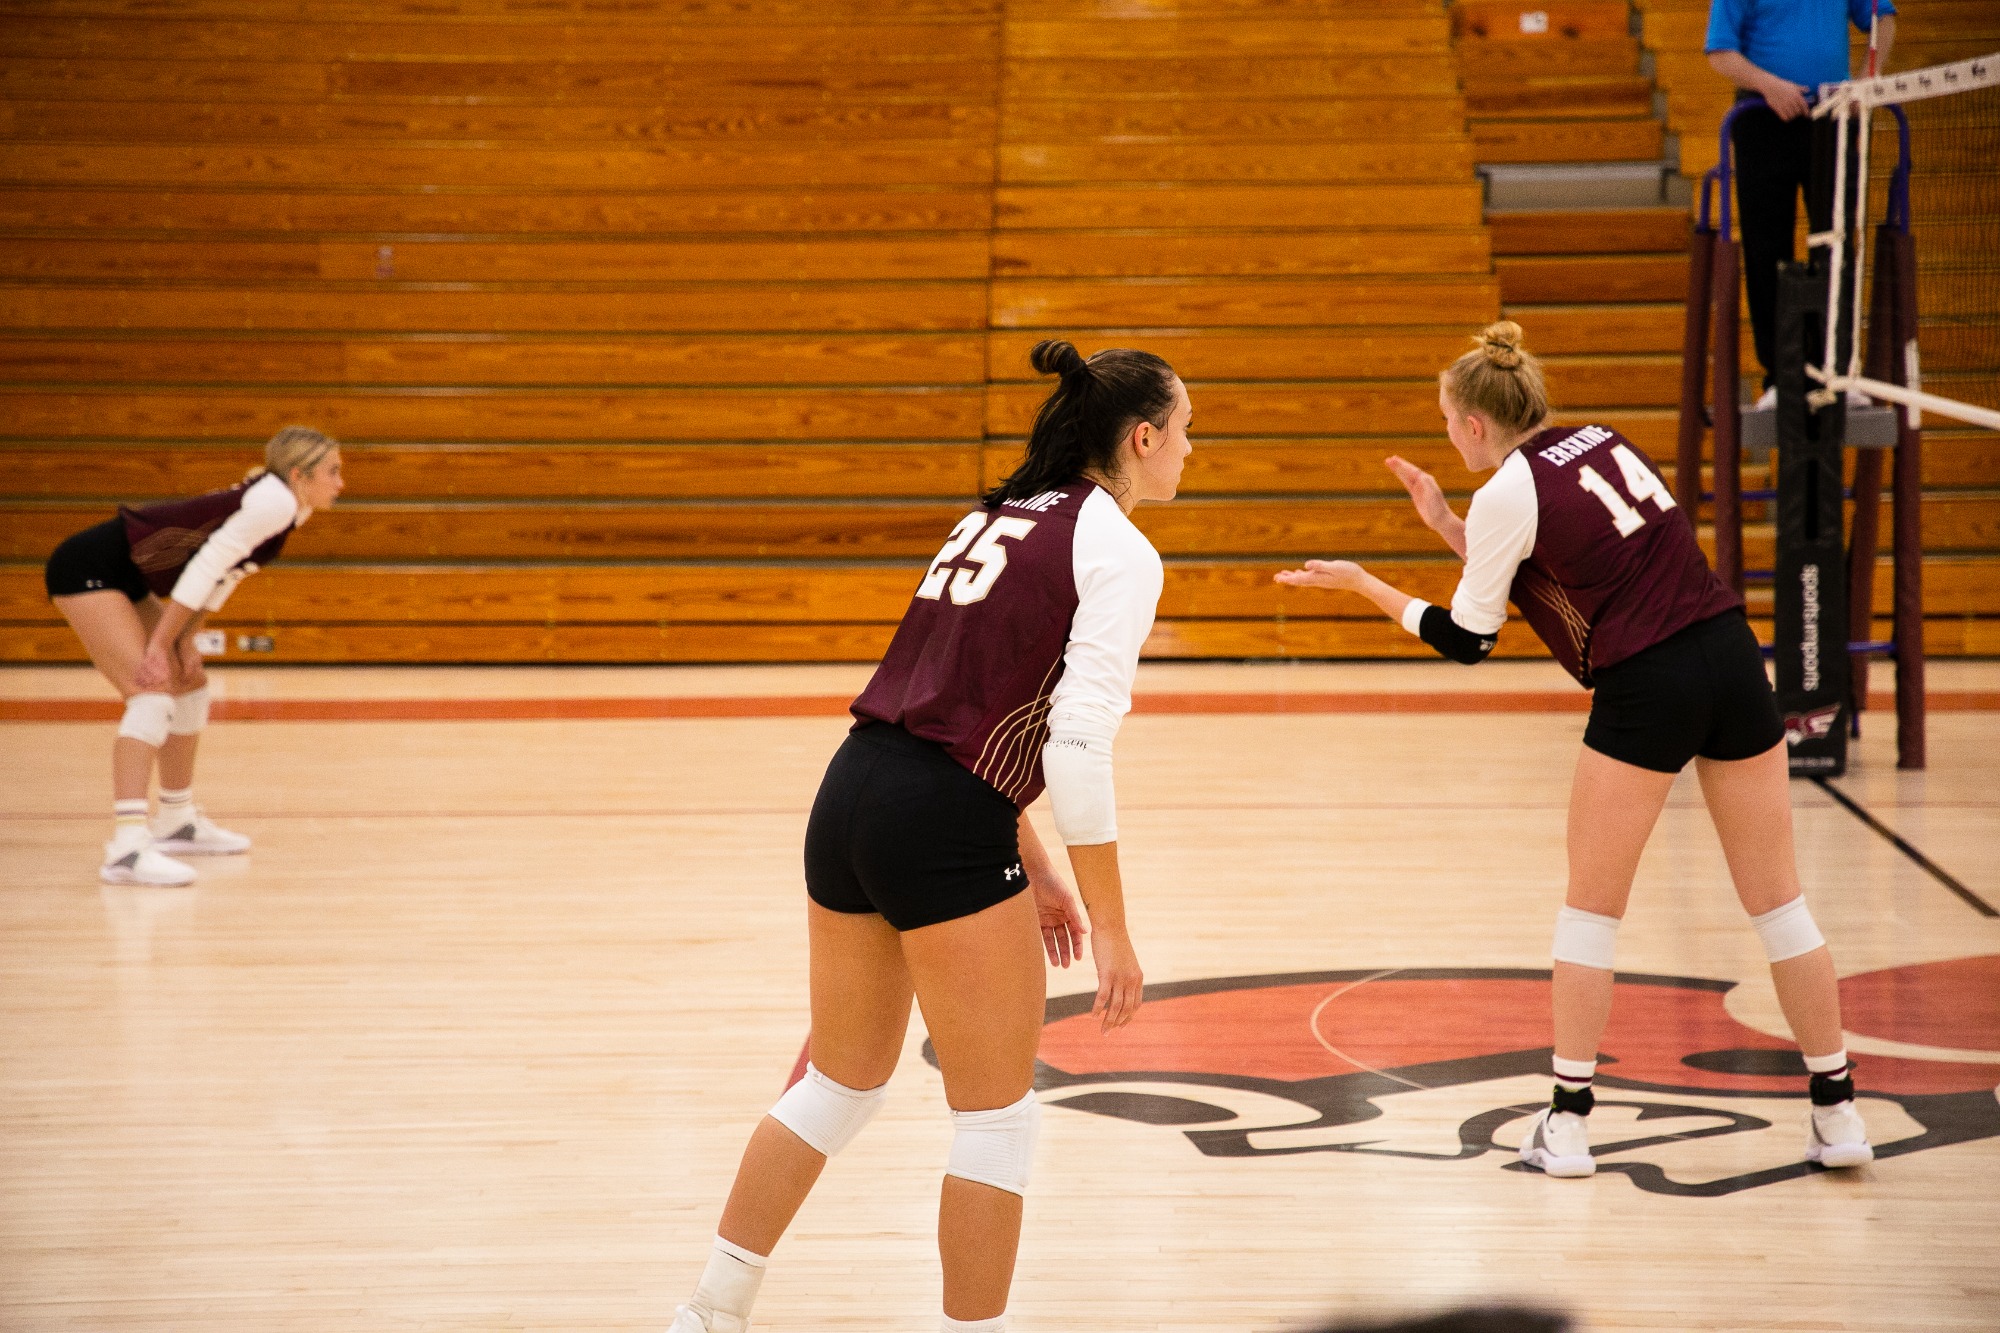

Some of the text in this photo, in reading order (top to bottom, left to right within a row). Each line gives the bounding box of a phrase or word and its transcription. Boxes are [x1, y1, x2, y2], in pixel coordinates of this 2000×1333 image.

[1538, 424, 1614, 467] ERSKINE
[1578, 443, 1678, 539] 14
[915, 510, 1038, 606] 25
